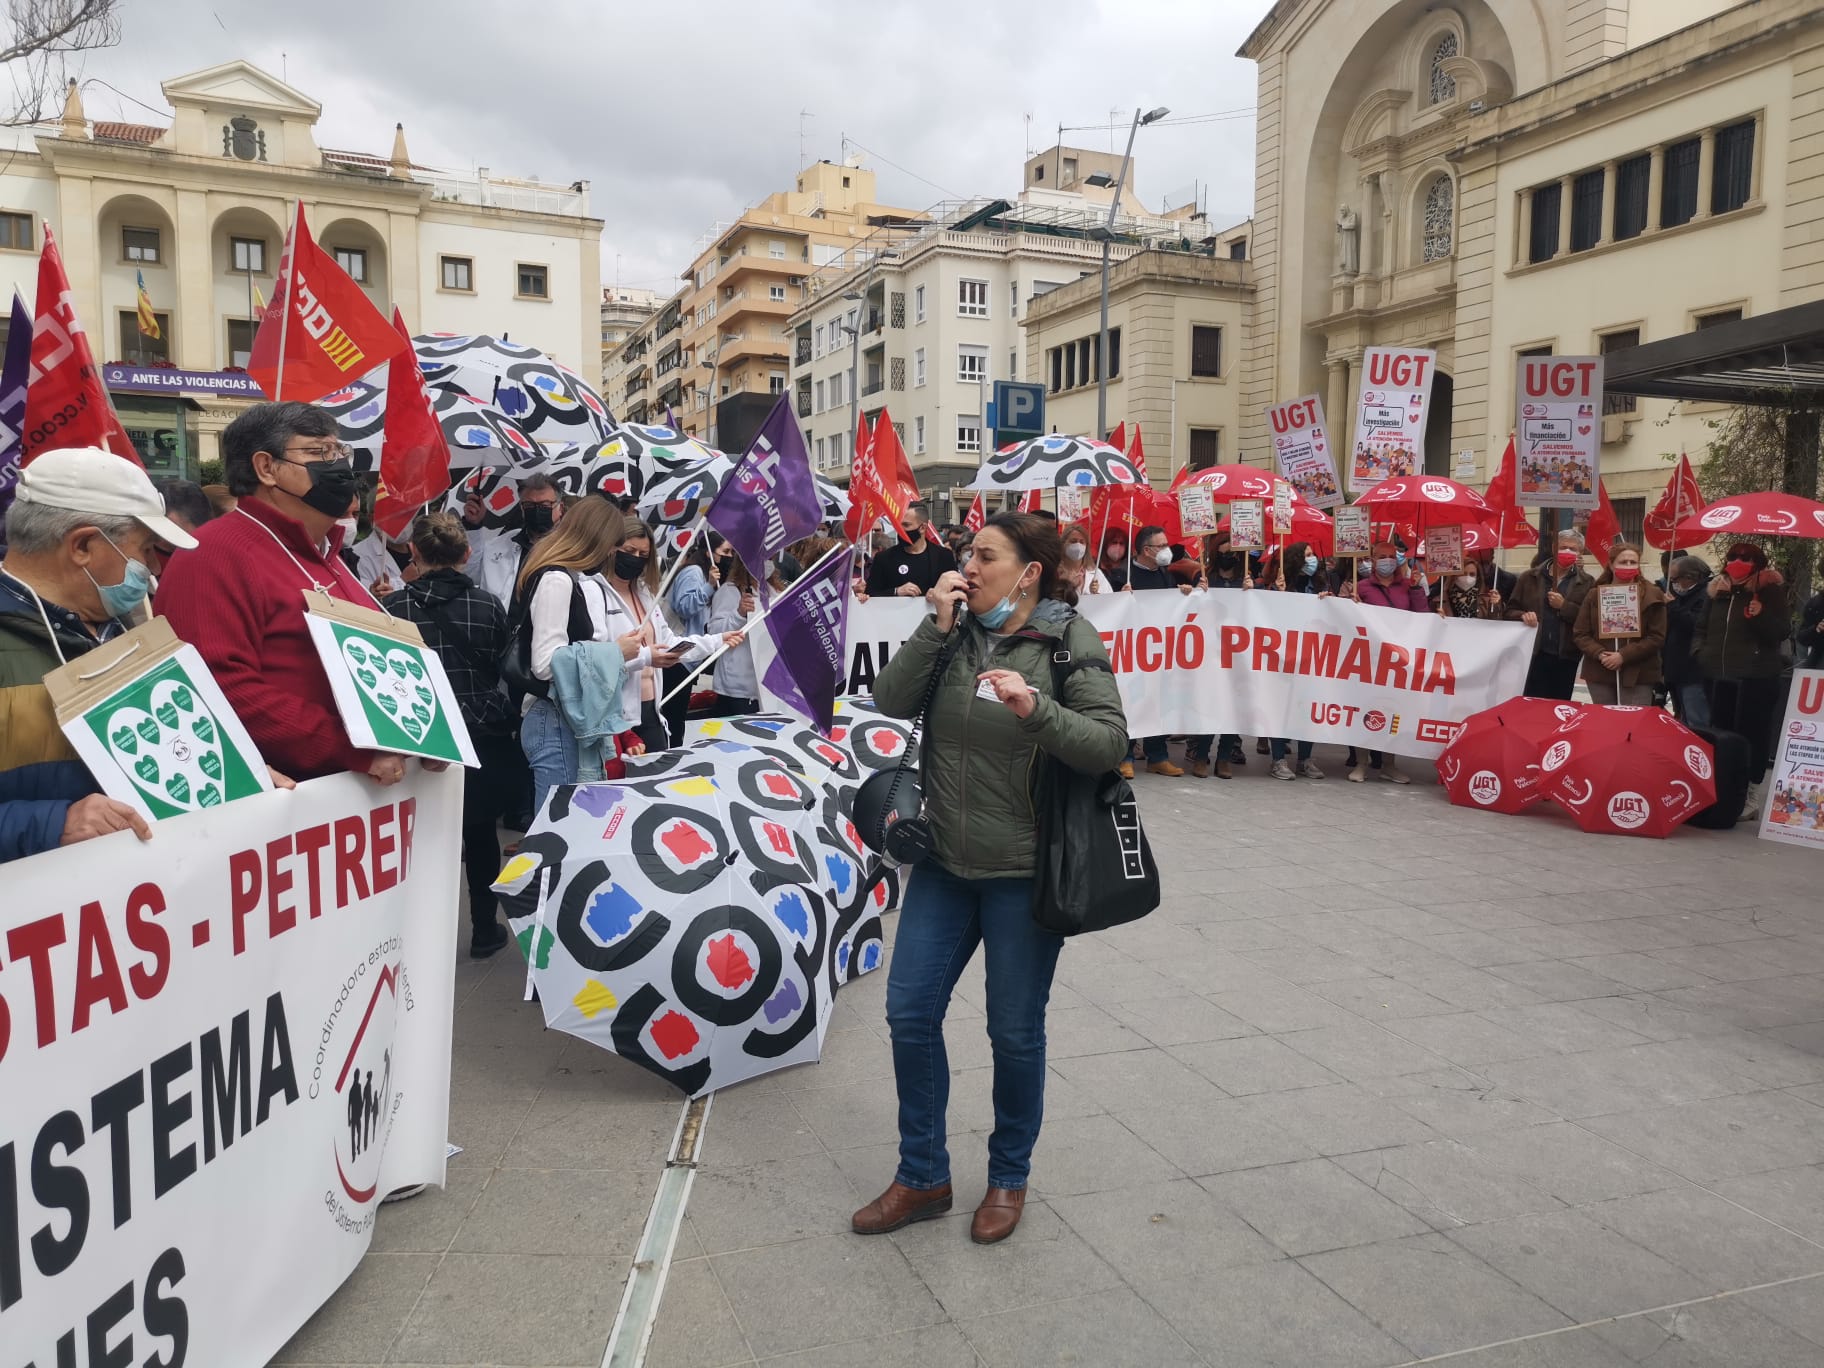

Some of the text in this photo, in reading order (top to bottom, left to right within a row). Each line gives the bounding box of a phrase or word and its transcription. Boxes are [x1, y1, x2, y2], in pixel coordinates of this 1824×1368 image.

[132, 373, 160, 385] ANTE
[162, 375, 183, 386] LAS
[185, 377, 246, 390] VIOLENCIAS
[1369, 353, 1430, 387] UGT
[1525, 362, 1596, 397] UGT
[1008, 388, 1034, 426] P
[1270, 399, 1317, 434] UGT
[1541, 422, 1555, 430] Más
[1425, 484, 1450, 493] UGT
[1710, 509, 1739, 518] UGT
[799, 590, 820, 618] país
[1220, 625, 1457, 696] PRIMÀRIA
[1310, 702, 1361, 728] UGT
[1472, 775, 1497, 790] UGT
[1612, 797, 1644, 812] UGT
[0, 881, 171, 1066] TAS
[229, 798, 417, 957] PETRER
[308, 962, 366, 1100] Coordinadora
